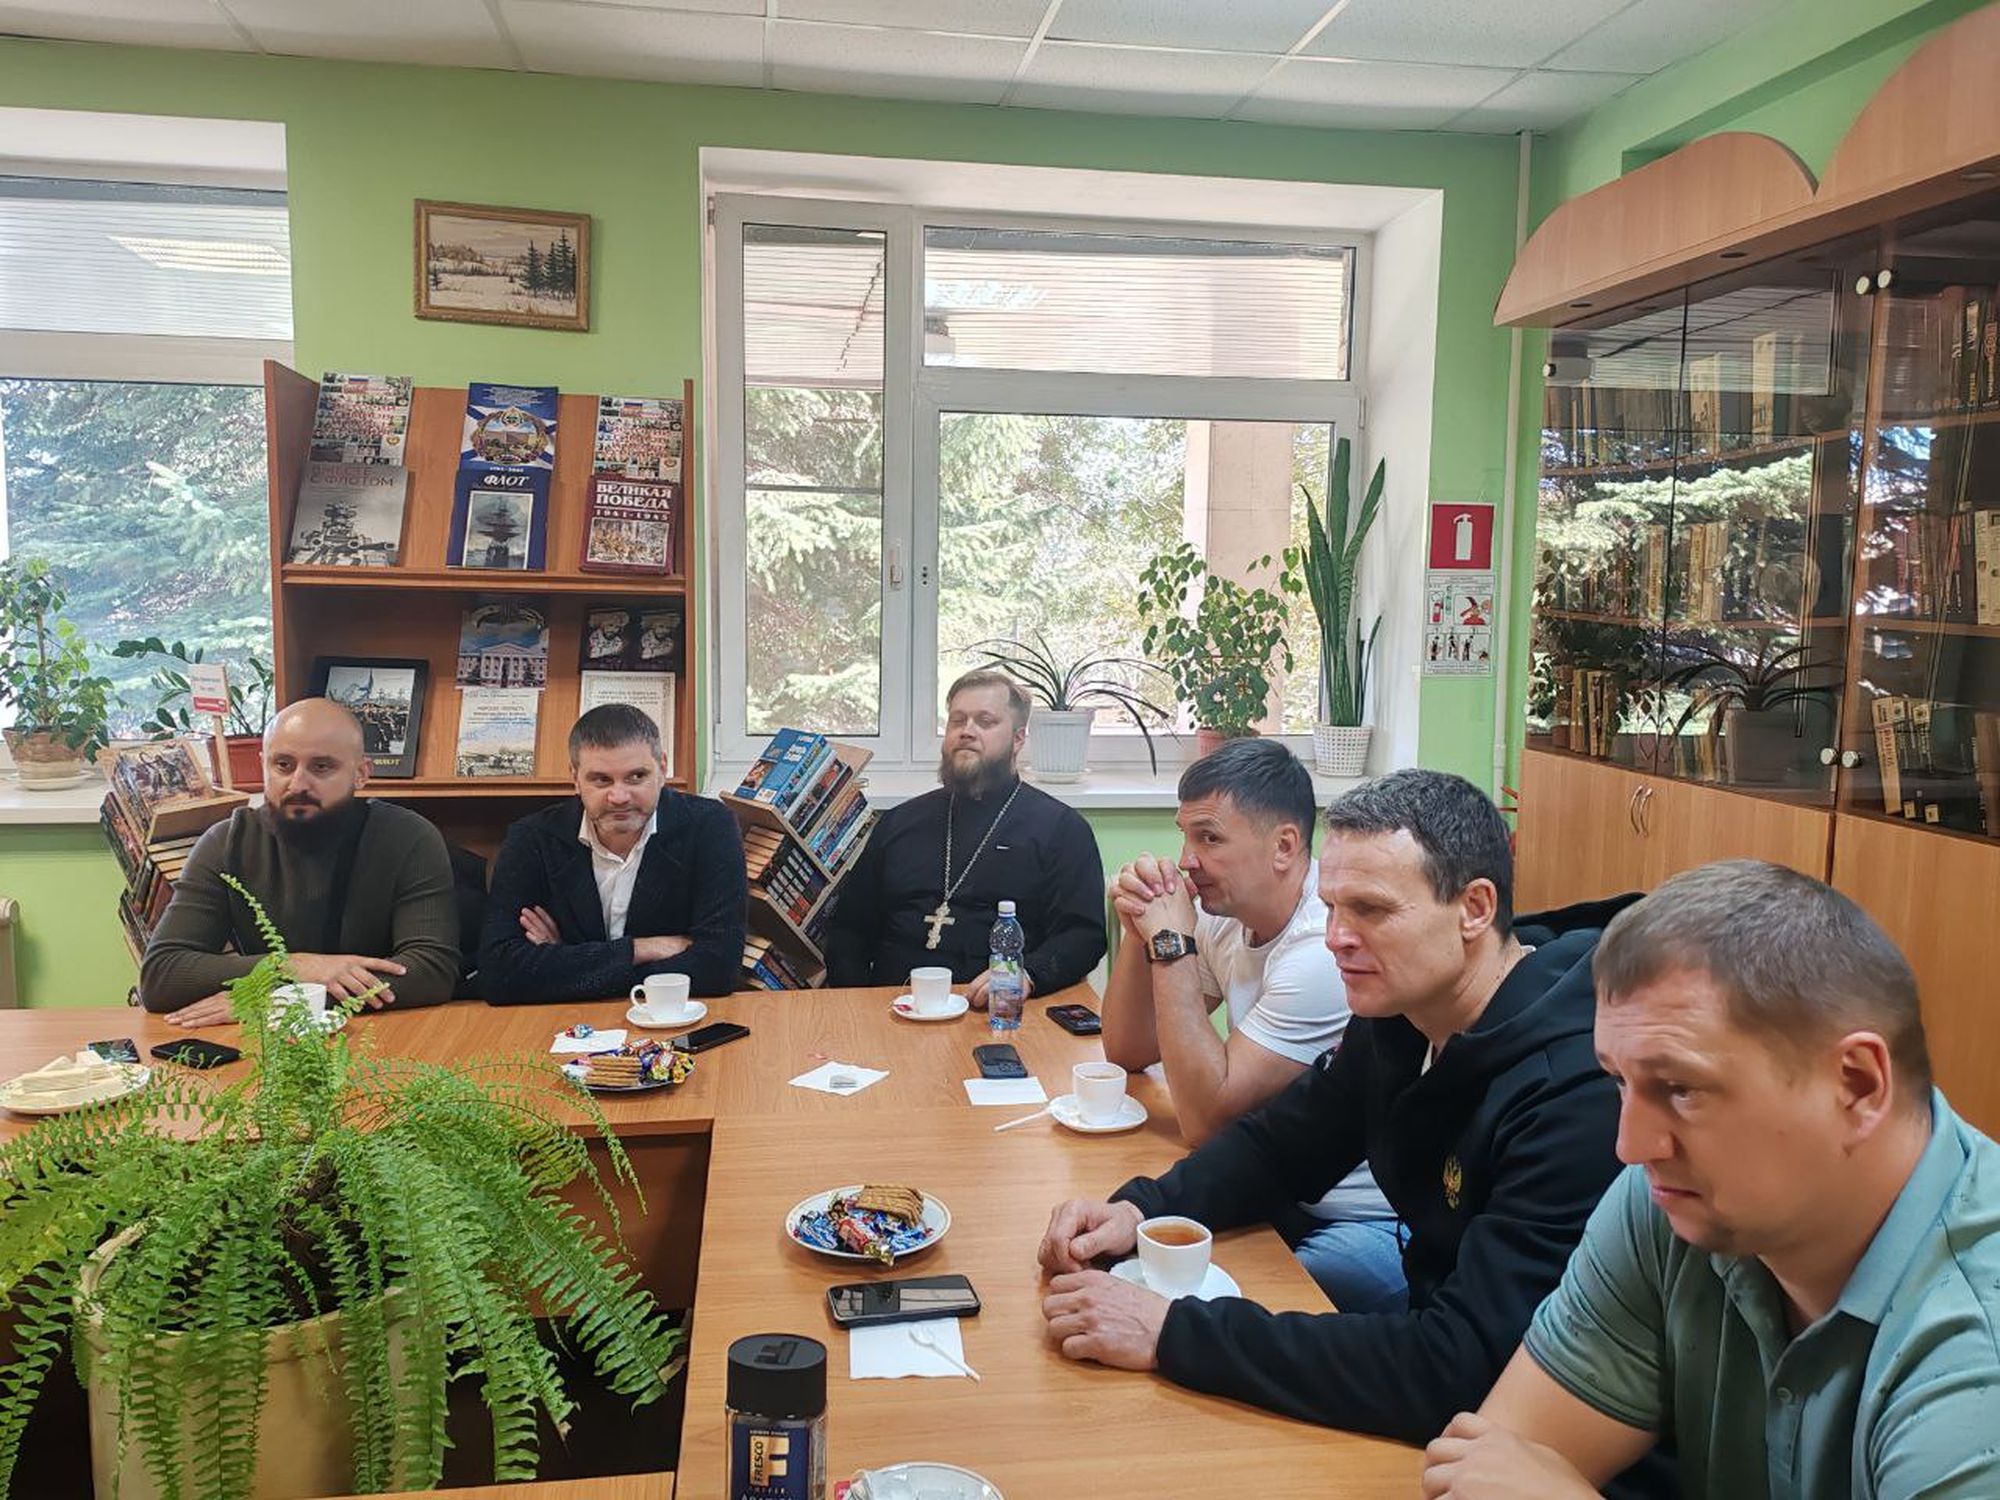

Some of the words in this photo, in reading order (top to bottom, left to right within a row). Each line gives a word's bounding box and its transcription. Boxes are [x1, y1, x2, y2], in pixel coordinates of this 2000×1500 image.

[483, 474, 530, 486] ФЛОТ
[596, 483, 672, 499] ВЕЛИКАЯ
[596, 493, 670, 510] ПОБЕДА
[596, 509, 668, 520] 1941-1945
[754, 1441, 764, 1482] FRESCO
